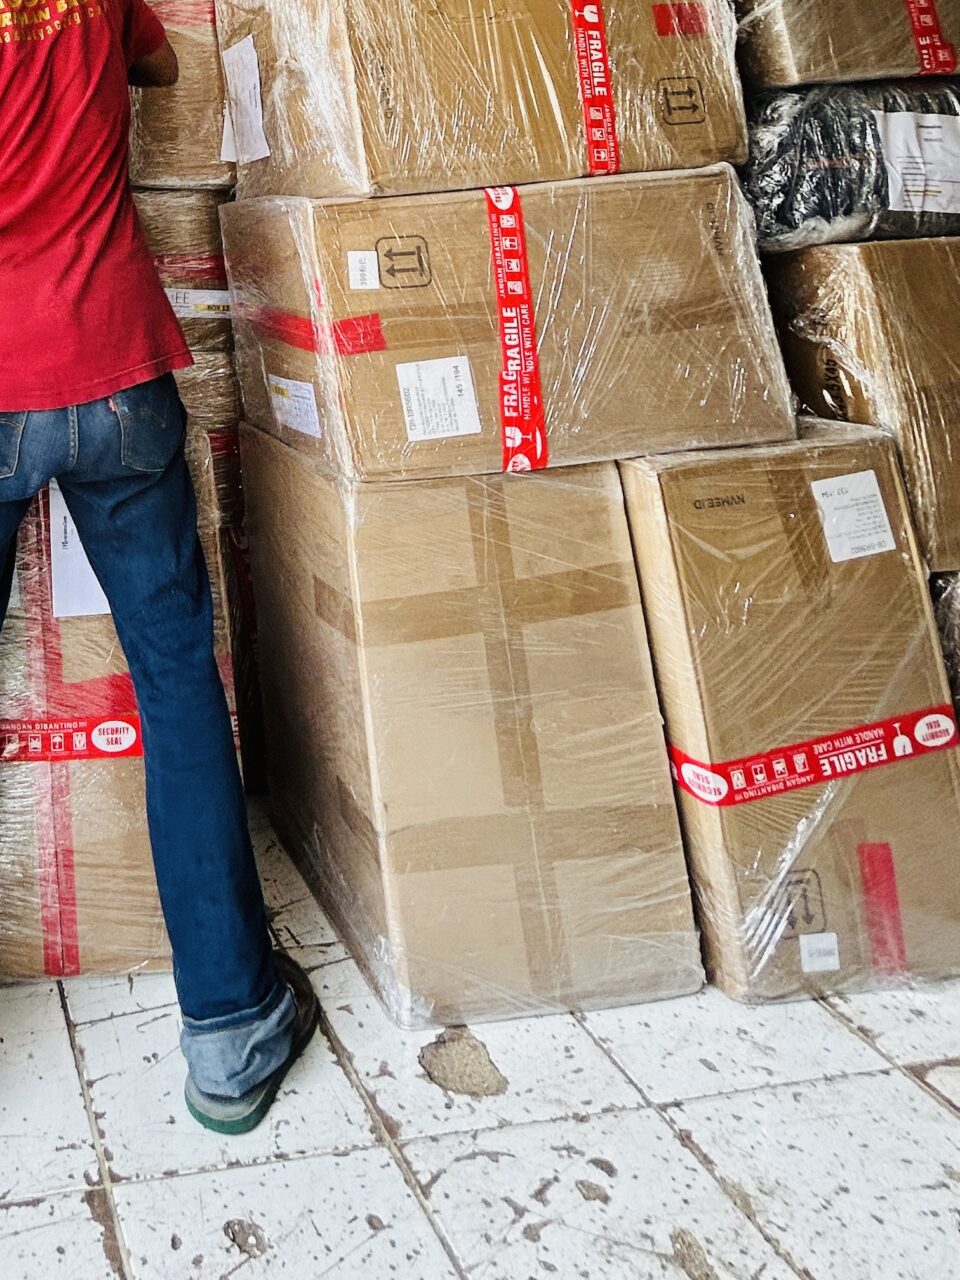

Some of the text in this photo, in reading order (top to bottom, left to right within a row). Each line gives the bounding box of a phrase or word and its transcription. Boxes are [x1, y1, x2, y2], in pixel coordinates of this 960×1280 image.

[577, 27, 592, 99] HANDLE WITH CARE
[588, 30, 607, 97] FRAGILE
[603, 104, 612, 134] JANGAN
[493, 223, 502, 265] DIBANTING
[497, 270, 506, 298] JANGAN
[520, 303, 529, 326] CARE
[522, 327, 533, 348] WITH
[455, 383, 465, 398] 145
[521, 387, 531, 420] HANDLE
[1, 722, 33, 731] JANGAN
[35, 722, 77, 730] DIBANTING
[97, 726, 130, 737] SECURITY
[922, 728, 951, 743] SECURITY
[926, 720, 941, 730] SEAL
[105, 736, 123, 746] SEAL
[812, 728, 885, 755] HANDLE WITH CARE
[819, 742, 889, 776] FRAGILE
[692, 770, 711, 782] SEAL
[787, 773, 815, 789] JANGAN
[743, 782, 785, 800] DIBANTING
